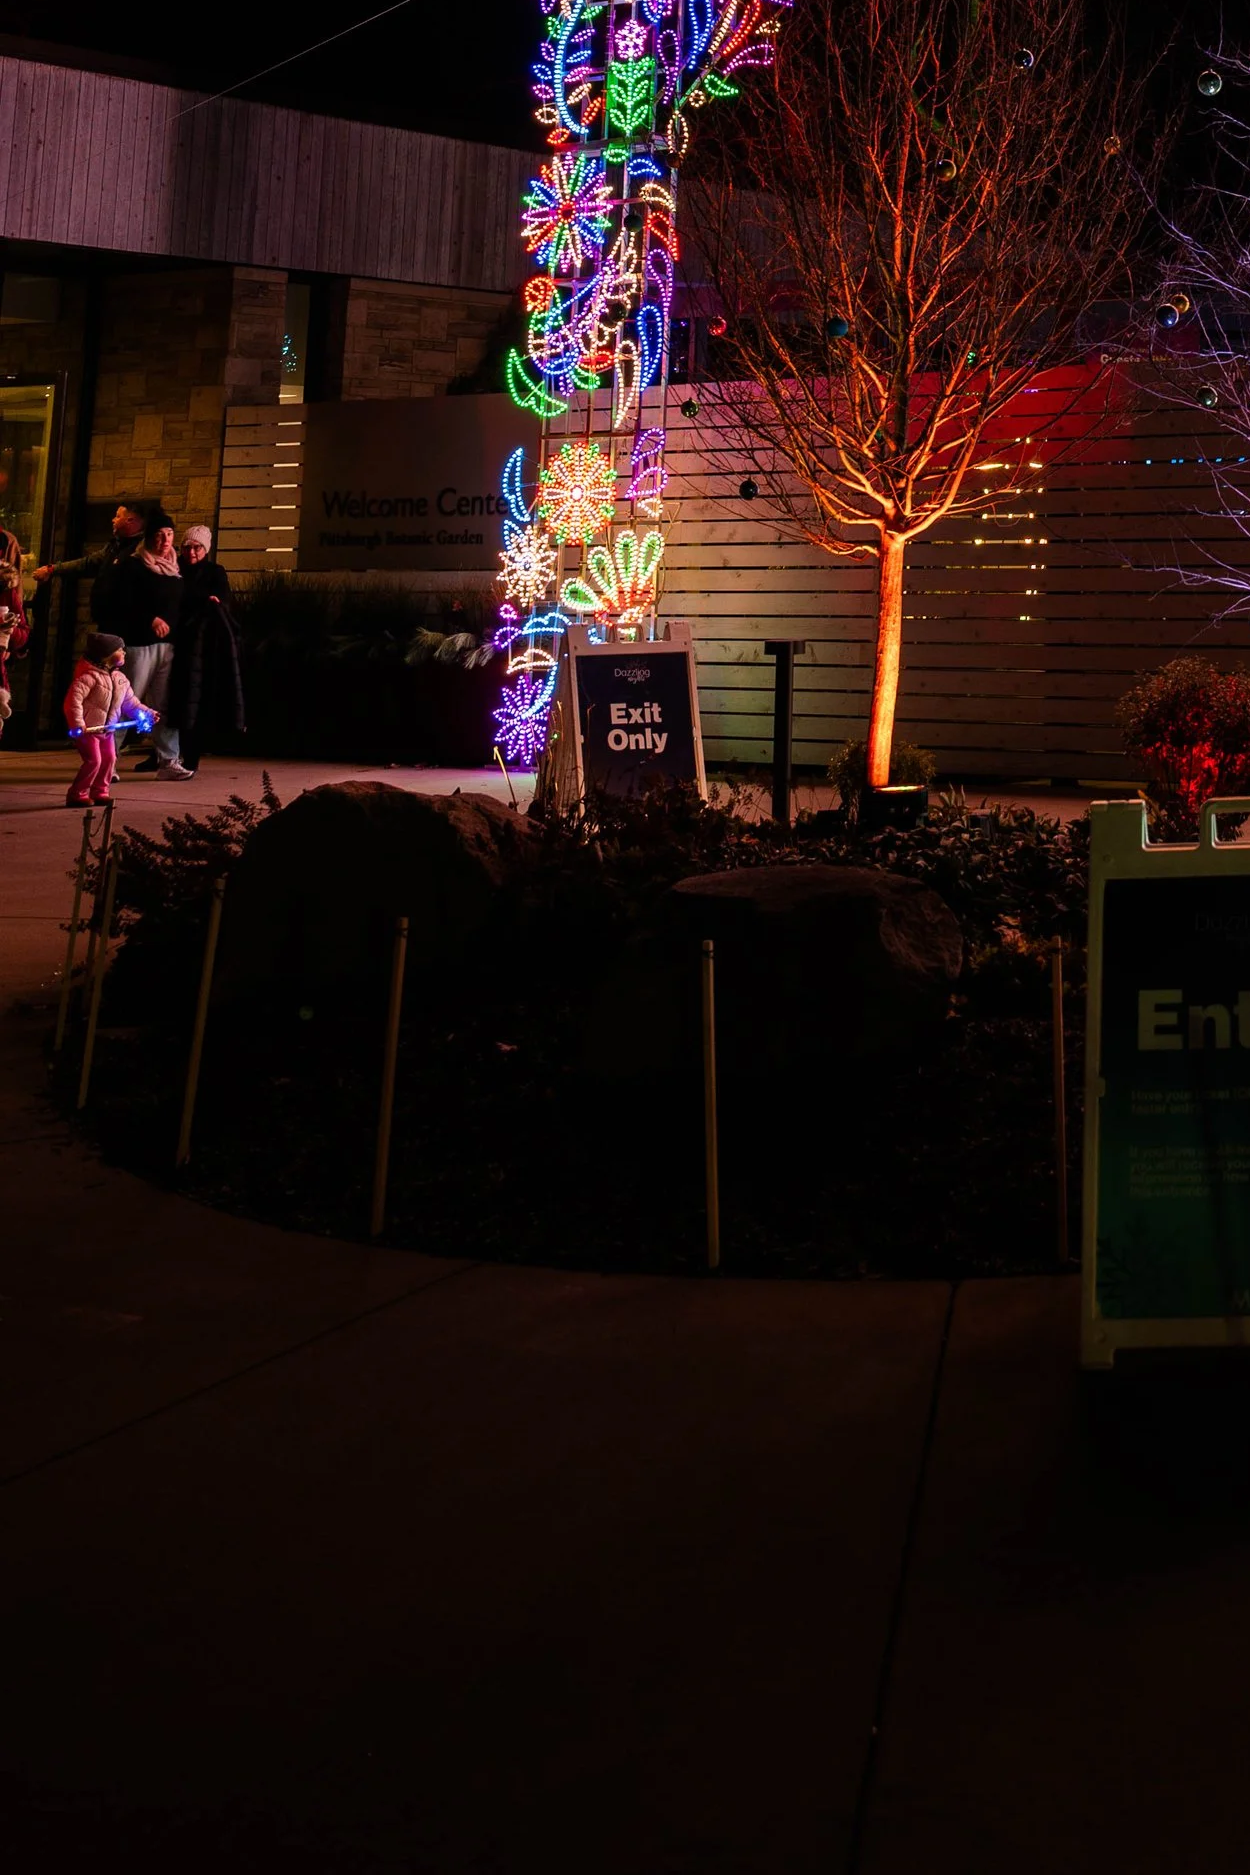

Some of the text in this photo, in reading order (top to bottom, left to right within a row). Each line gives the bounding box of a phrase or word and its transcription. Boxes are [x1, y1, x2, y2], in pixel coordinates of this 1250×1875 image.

[321, 488, 511, 519] Welcome Cente
[386, 530, 434, 546] Botanic
[437, 529, 484, 545] Garden
[610, 701, 663, 725] Exit
[607, 727, 669, 754] Only
